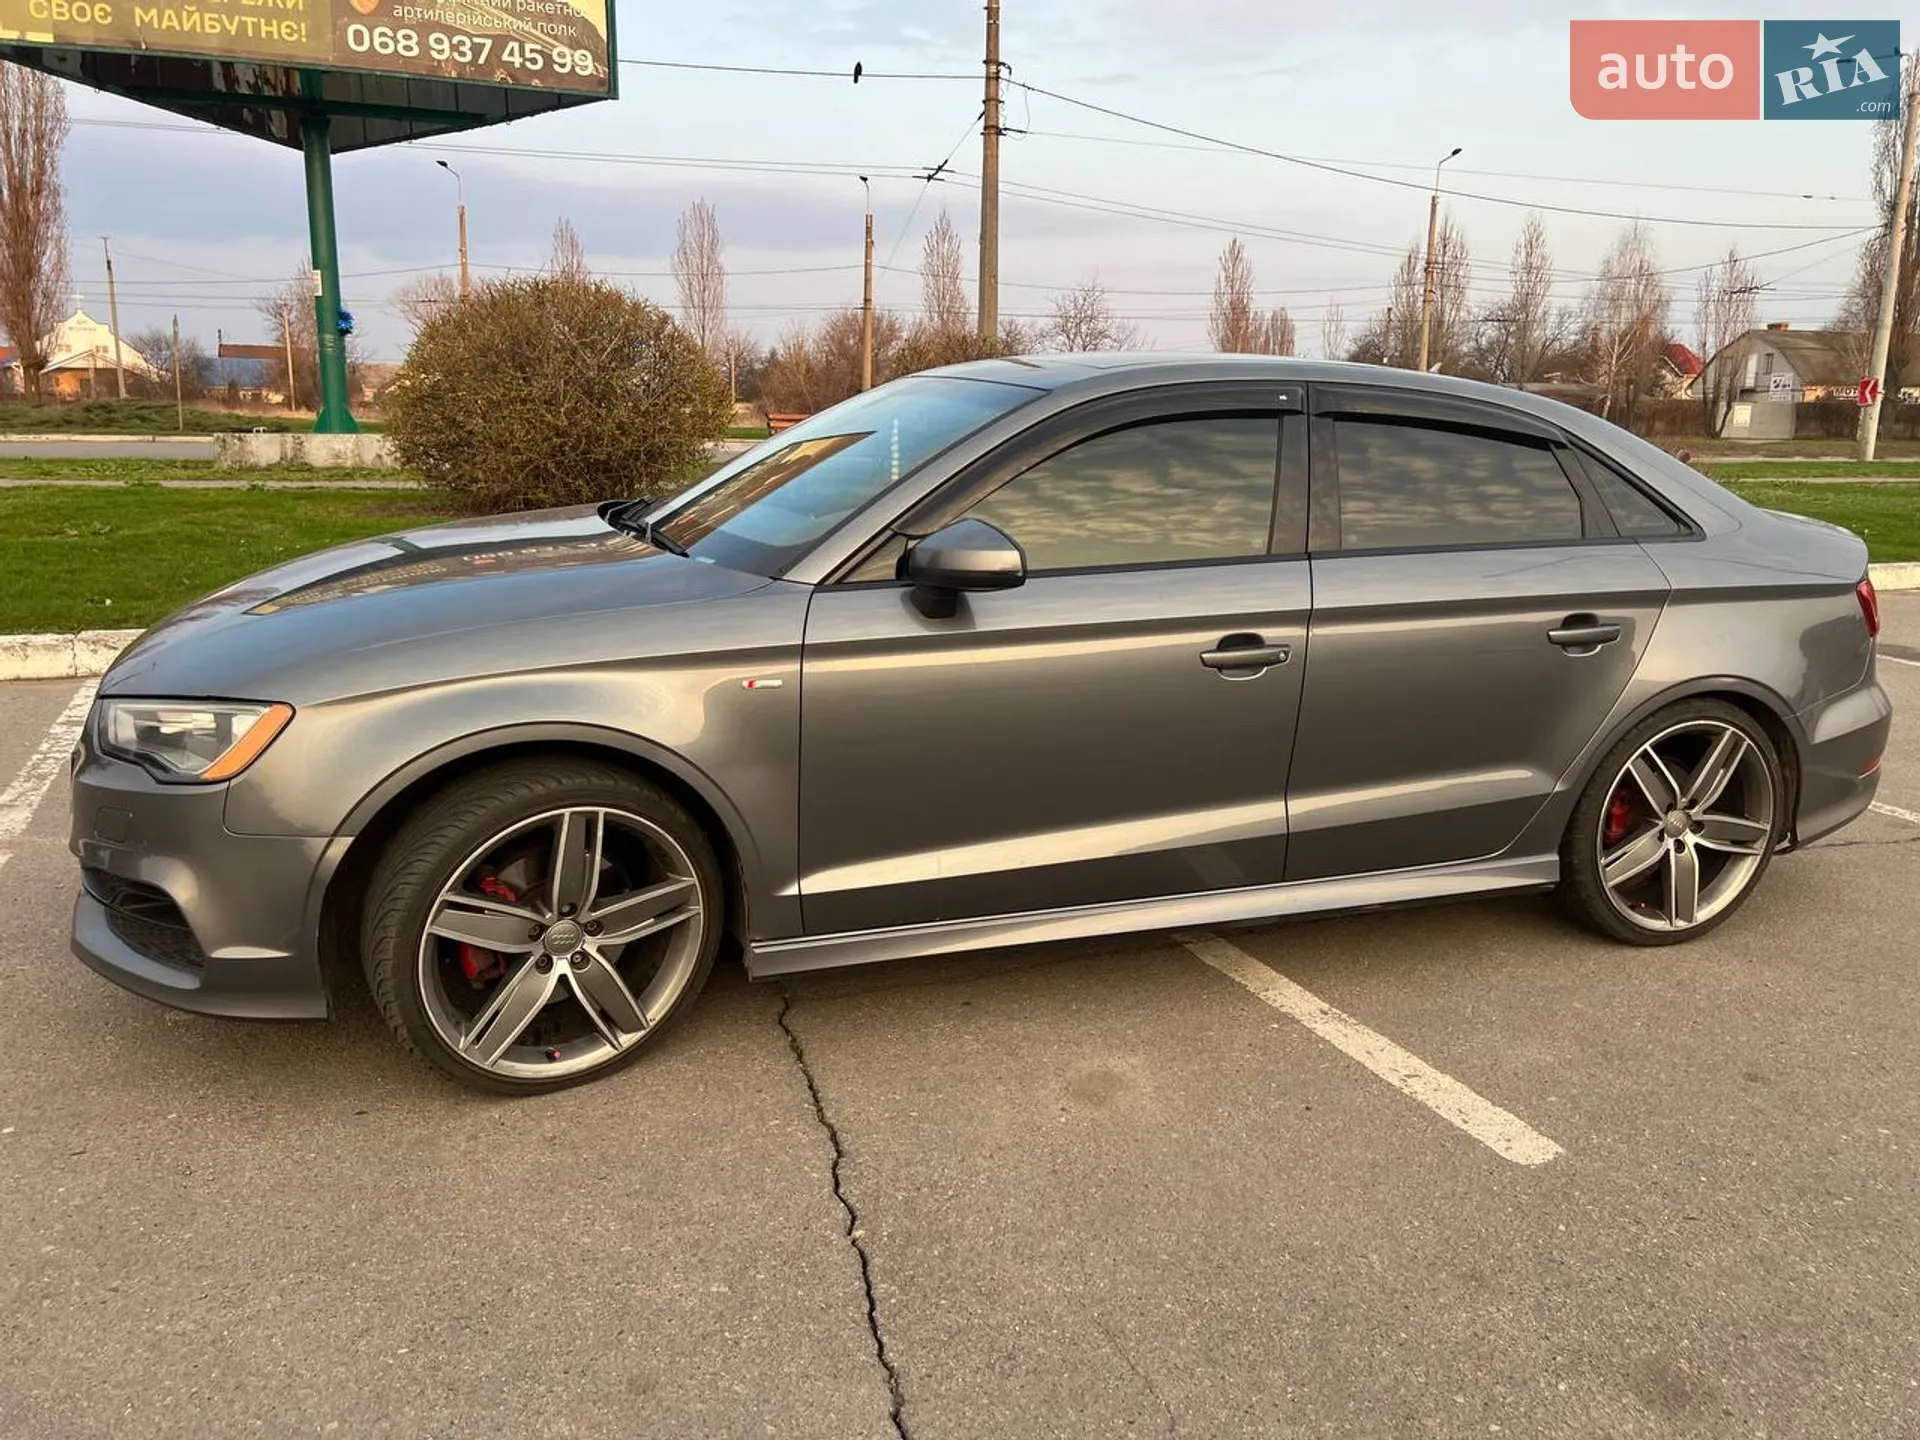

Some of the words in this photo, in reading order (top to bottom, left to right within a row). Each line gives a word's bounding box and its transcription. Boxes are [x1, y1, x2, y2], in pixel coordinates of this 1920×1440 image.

[29, 0, 113, 25] СВОЄ
[134, 6, 307, 42] МАЙБУТНЄ!
[393, 5, 533, 31] артилерійський
[536, 22, 578, 37] полк
[347, 23, 419, 57] 068
[429, 32, 493, 64] 937
[502, 41, 544, 71] 45
[551, 47, 594, 76] 99
